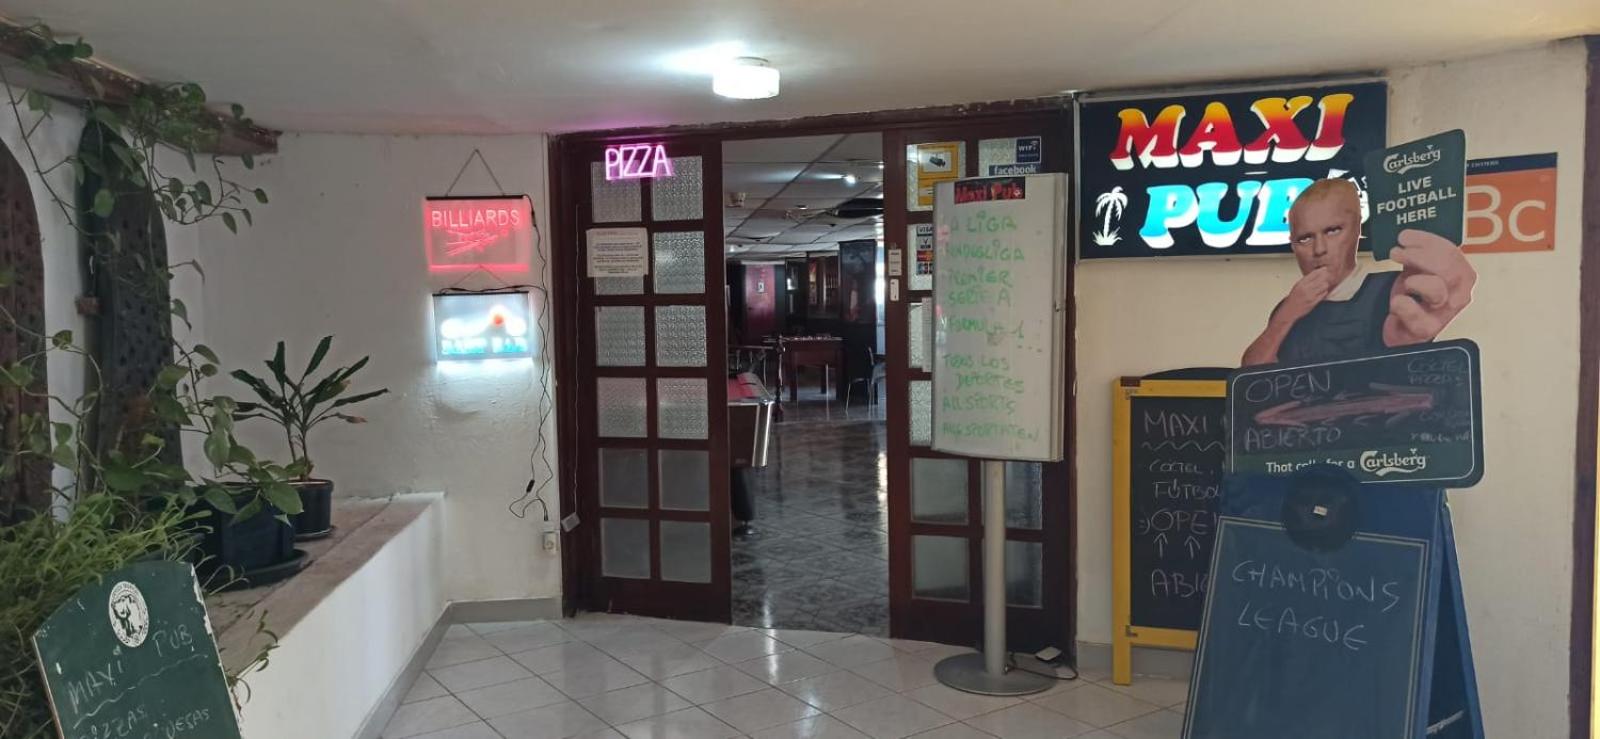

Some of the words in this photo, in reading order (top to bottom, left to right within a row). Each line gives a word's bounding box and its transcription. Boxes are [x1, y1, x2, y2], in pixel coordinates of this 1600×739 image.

[1109, 93, 1355, 171] MAXI
[605, 143, 672, 181] PIZZA
[994, 164, 1037, 175] facebook
[1383, 144, 1441, 175] Carlsberg
[1398, 176, 1432, 195] LIVE
[1139, 177, 1316, 249] PUB
[1377, 187, 1456, 214] FOOTBALL
[1464, 184, 1546, 245] Bc
[431, 209, 520, 228] BILLIARDS
[1396, 206, 1437, 225] HERE
[981, 354, 1009, 371] LOS
[1245, 369, 1331, 402] OPEN
[1143, 409, 1208, 438] MAXI
[1245, 426, 1341, 452] ABIERTO
[1266, 461, 1293, 473] That
[1346, 460, 1356, 469] a
[1360, 448, 1426, 477] Carlsberg
[1150, 507, 1217, 535] OPE
[1237, 601, 1368, 650] LEAGUE
[152, 623, 193, 658] PUB
